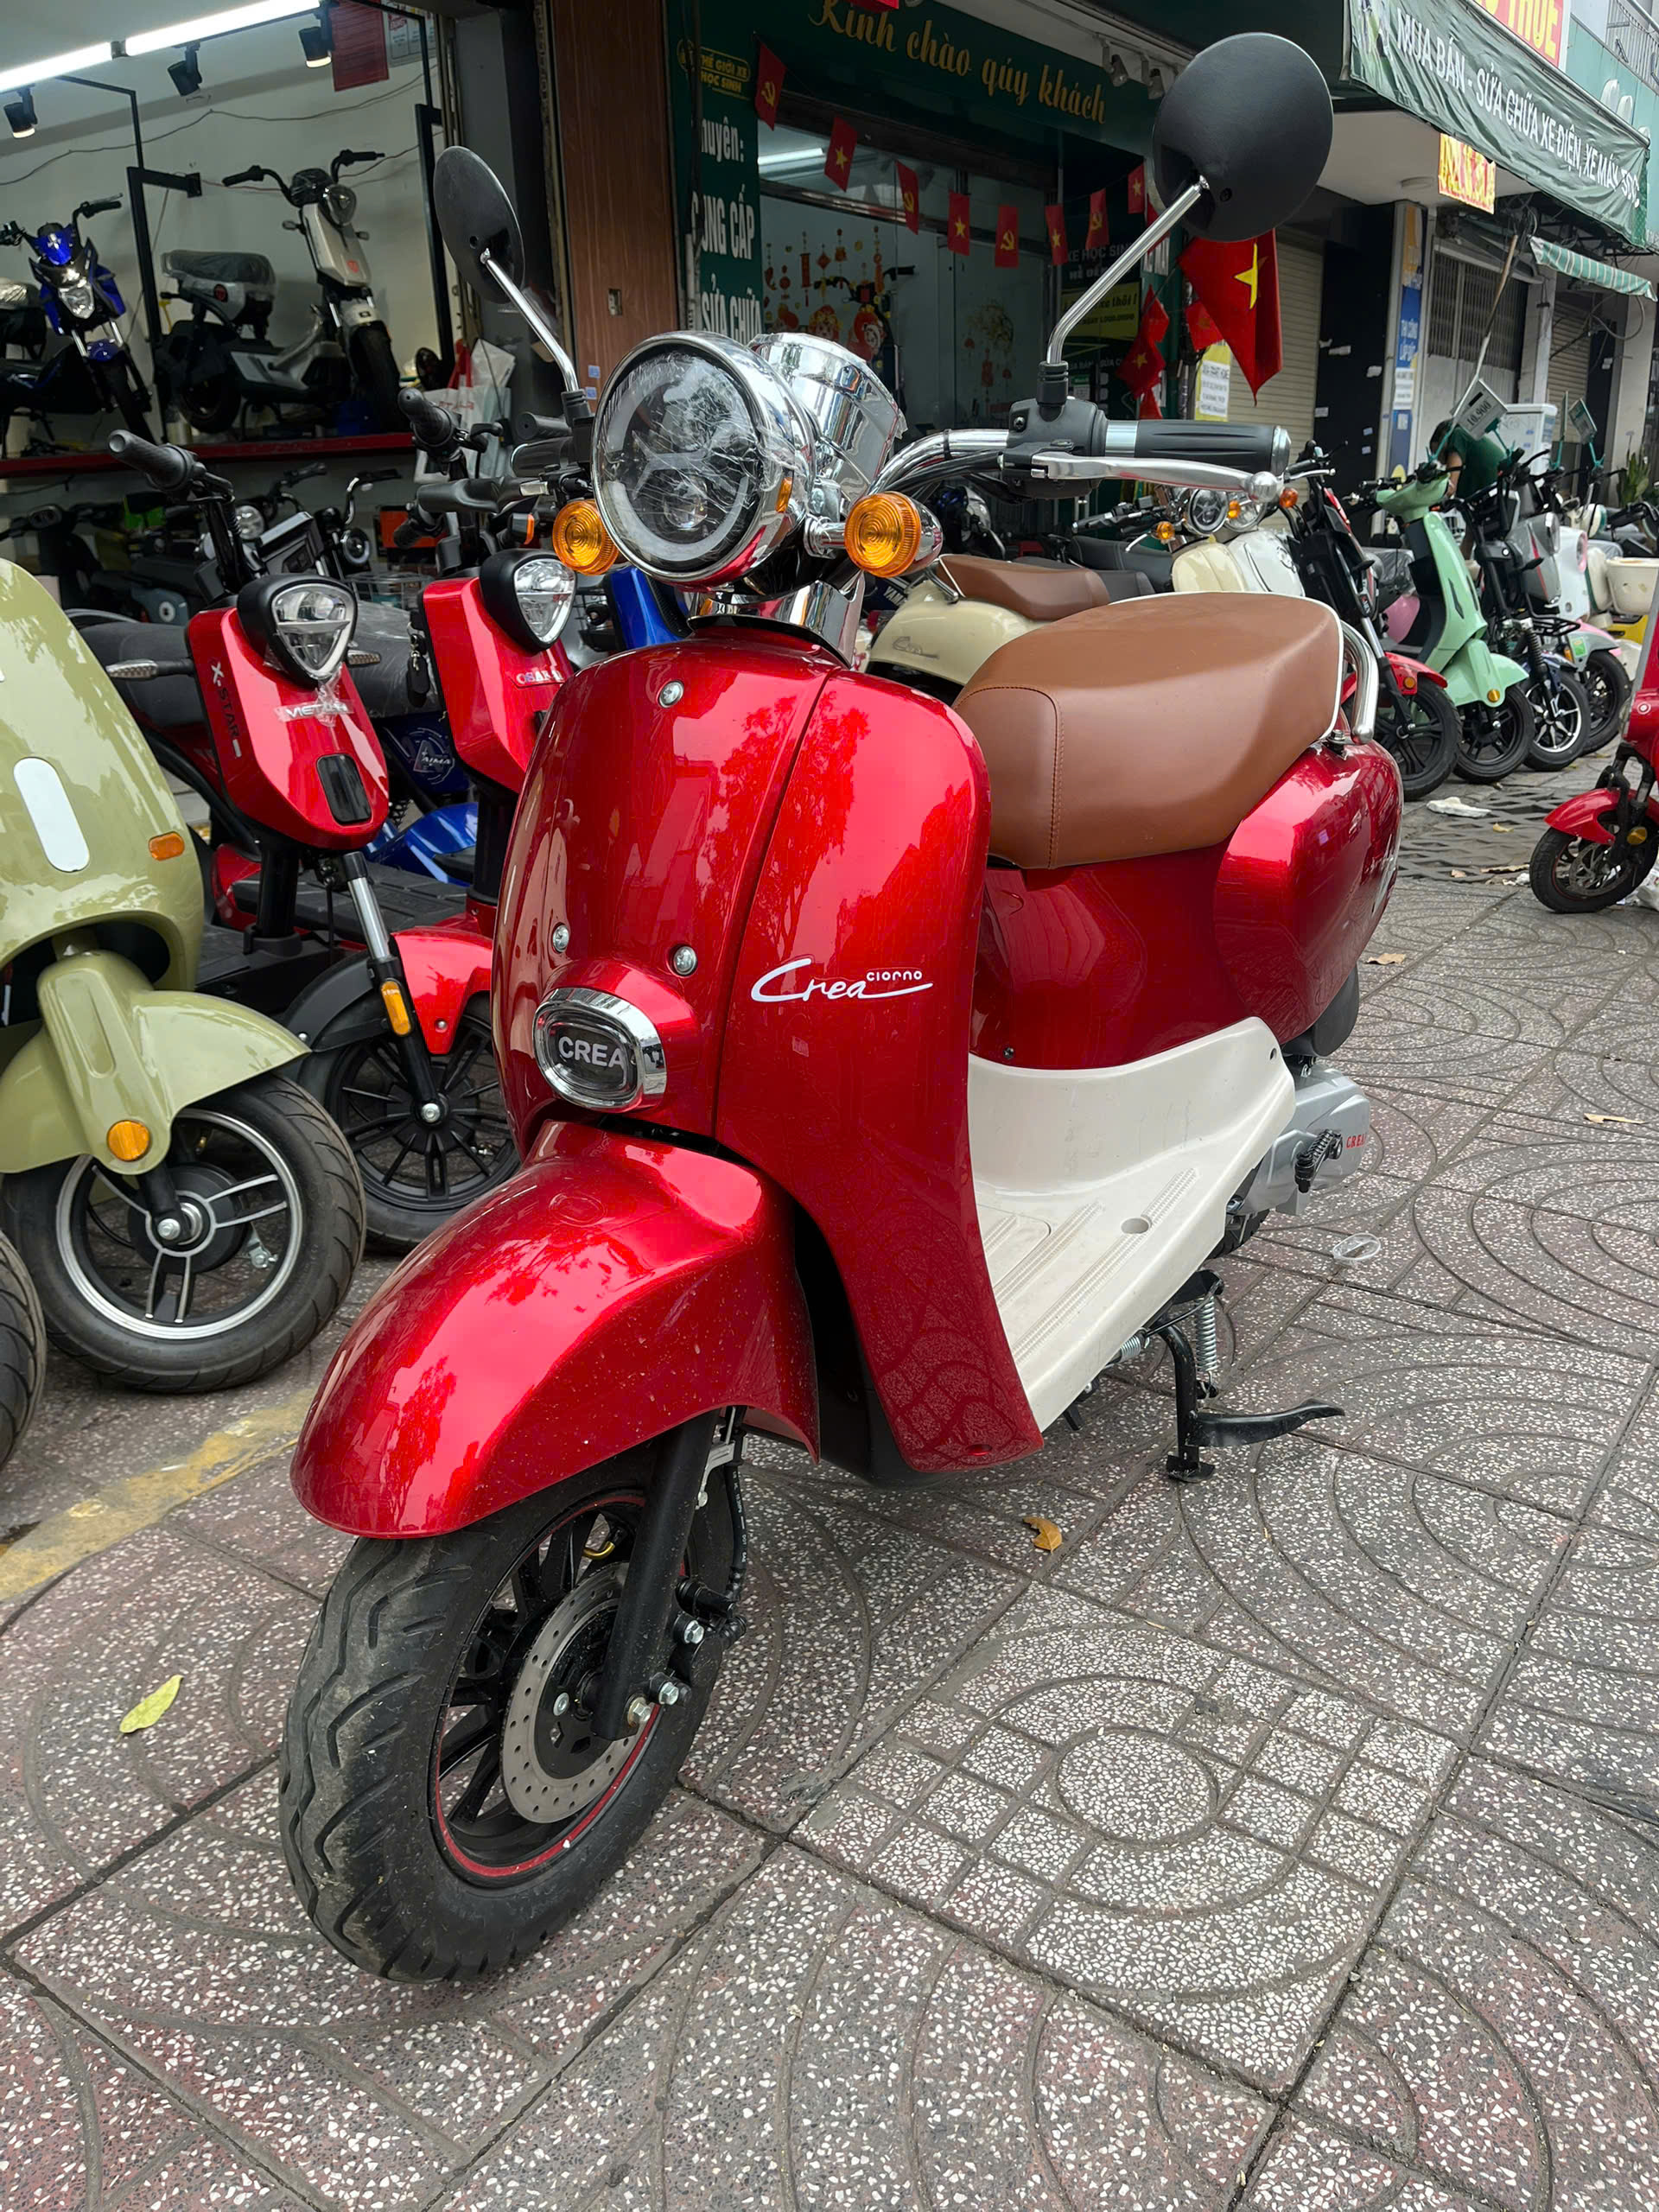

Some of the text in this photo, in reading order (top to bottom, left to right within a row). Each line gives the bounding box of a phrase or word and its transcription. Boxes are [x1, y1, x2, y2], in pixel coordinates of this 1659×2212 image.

[906, 20, 972, 76] chào
[1038, 65, 1105, 124] khách
[1396, 7, 1433, 71] MUA
[1436, 36, 1466, 93] BÁN
[1476, 61, 1503, 120] SỬA
[1506, 89, 1539, 143] CHỮA
[1541, 112, 1556, 153] XE
[1583, 143, 1599, 181] XE
[1598, 153, 1619, 192] MÁY
[729, 182, 755, 260] CẤP
[751, 958, 934, 1003] Crea
[558, 1035, 626, 1068] CREA
